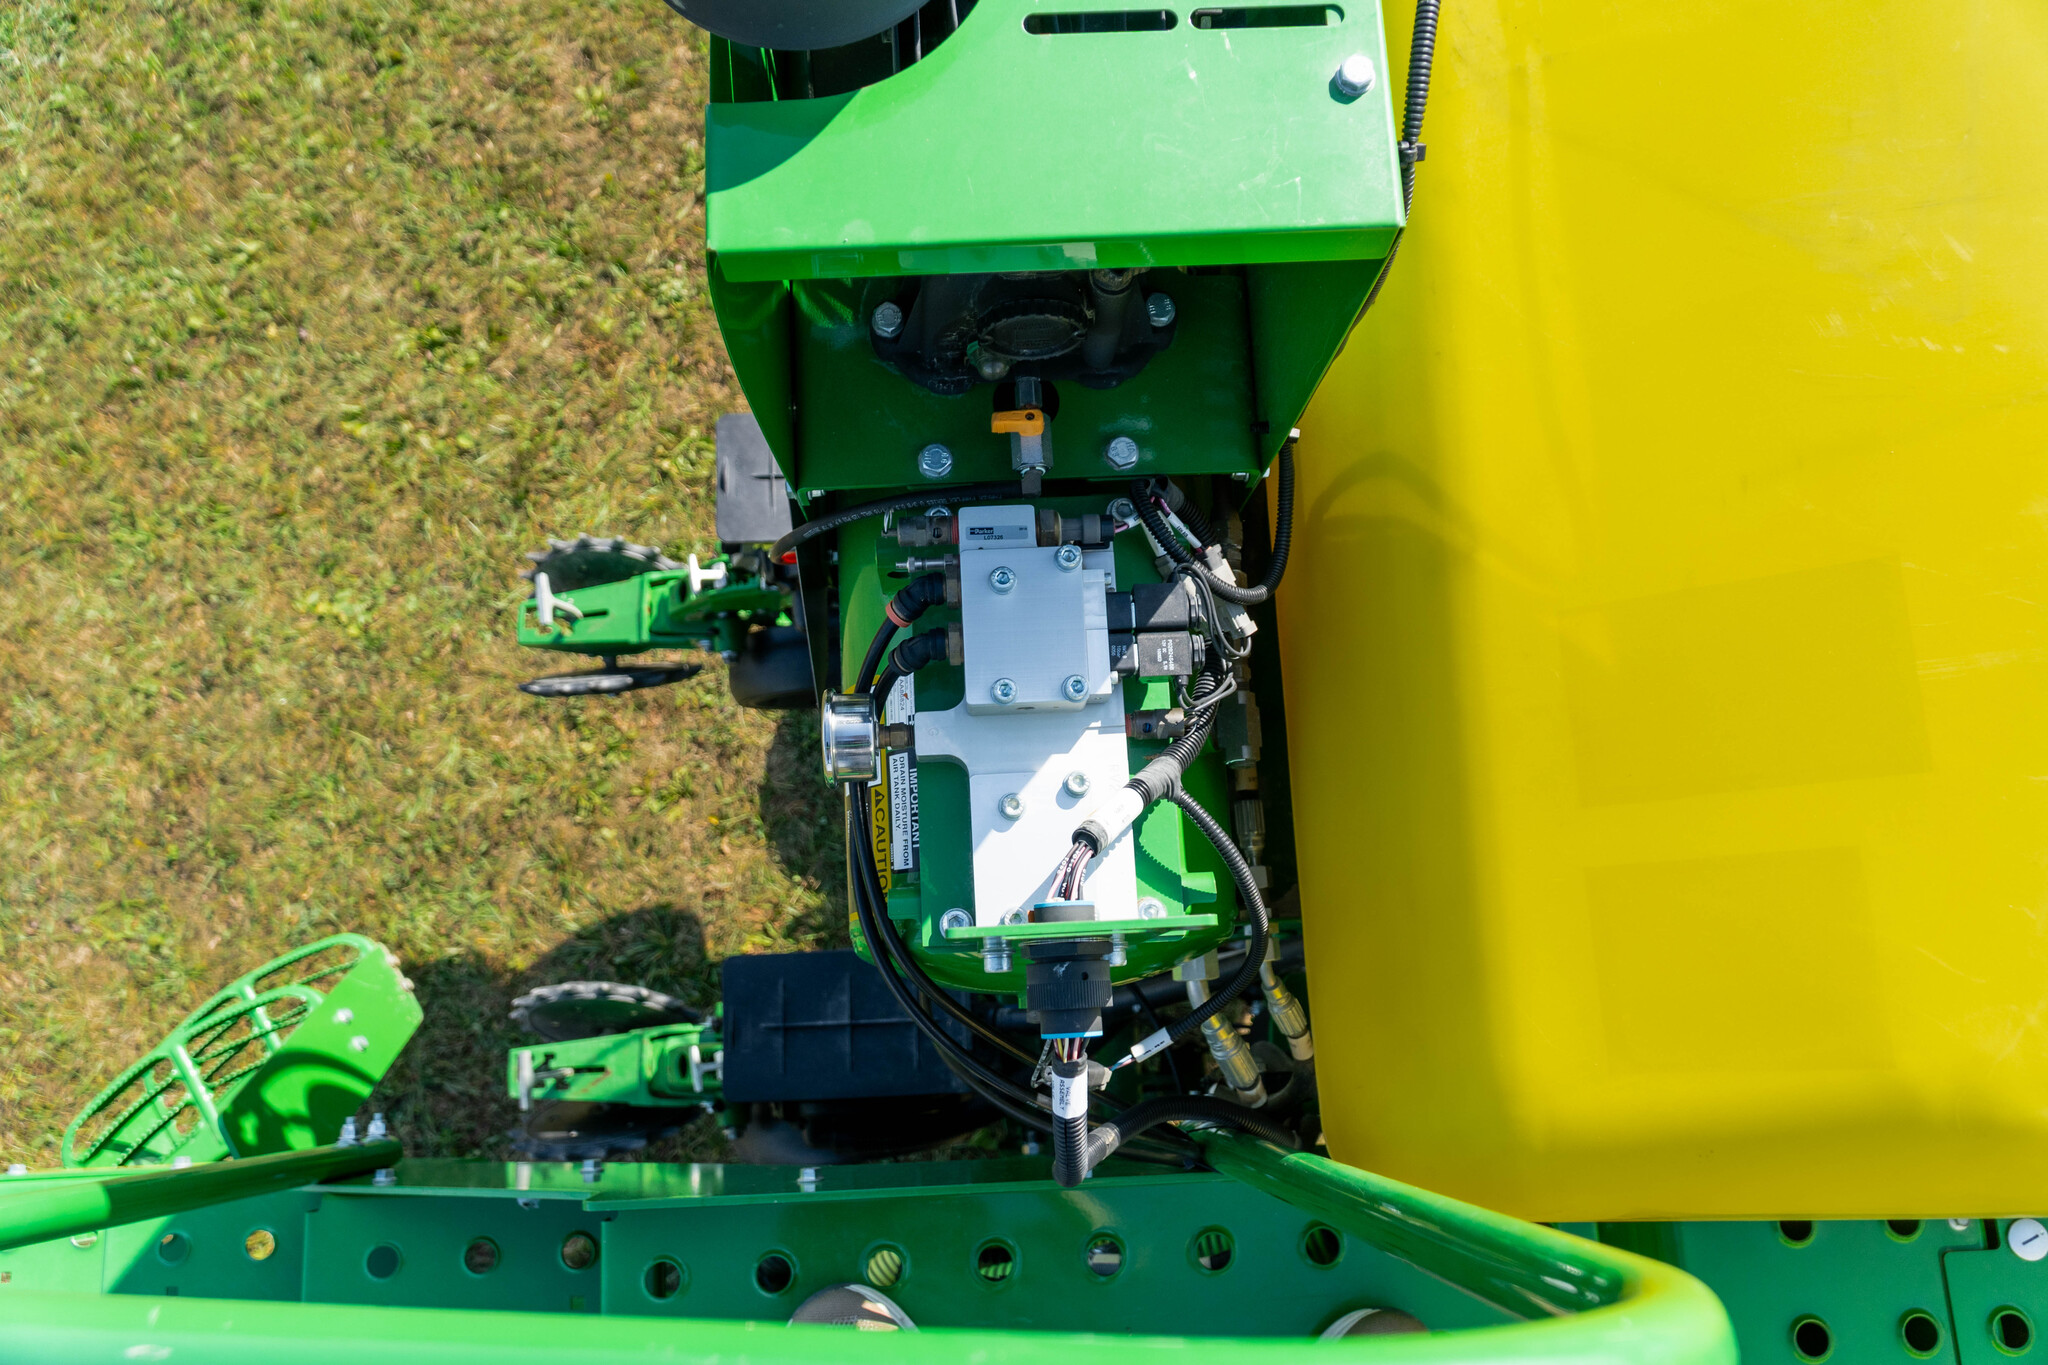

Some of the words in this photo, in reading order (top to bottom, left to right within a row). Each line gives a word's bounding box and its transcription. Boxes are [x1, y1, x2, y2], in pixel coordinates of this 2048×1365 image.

[893, 775, 901, 800] TANK
[898, 756, 907, 785] DRAIN
[894, 803, 902, 831] DAILY.
[901, 787, 909, 836] MOISTURE
[909, 768, 920, 848] IMPORTANT
[875, 808, 888, 896] CAUTIO
